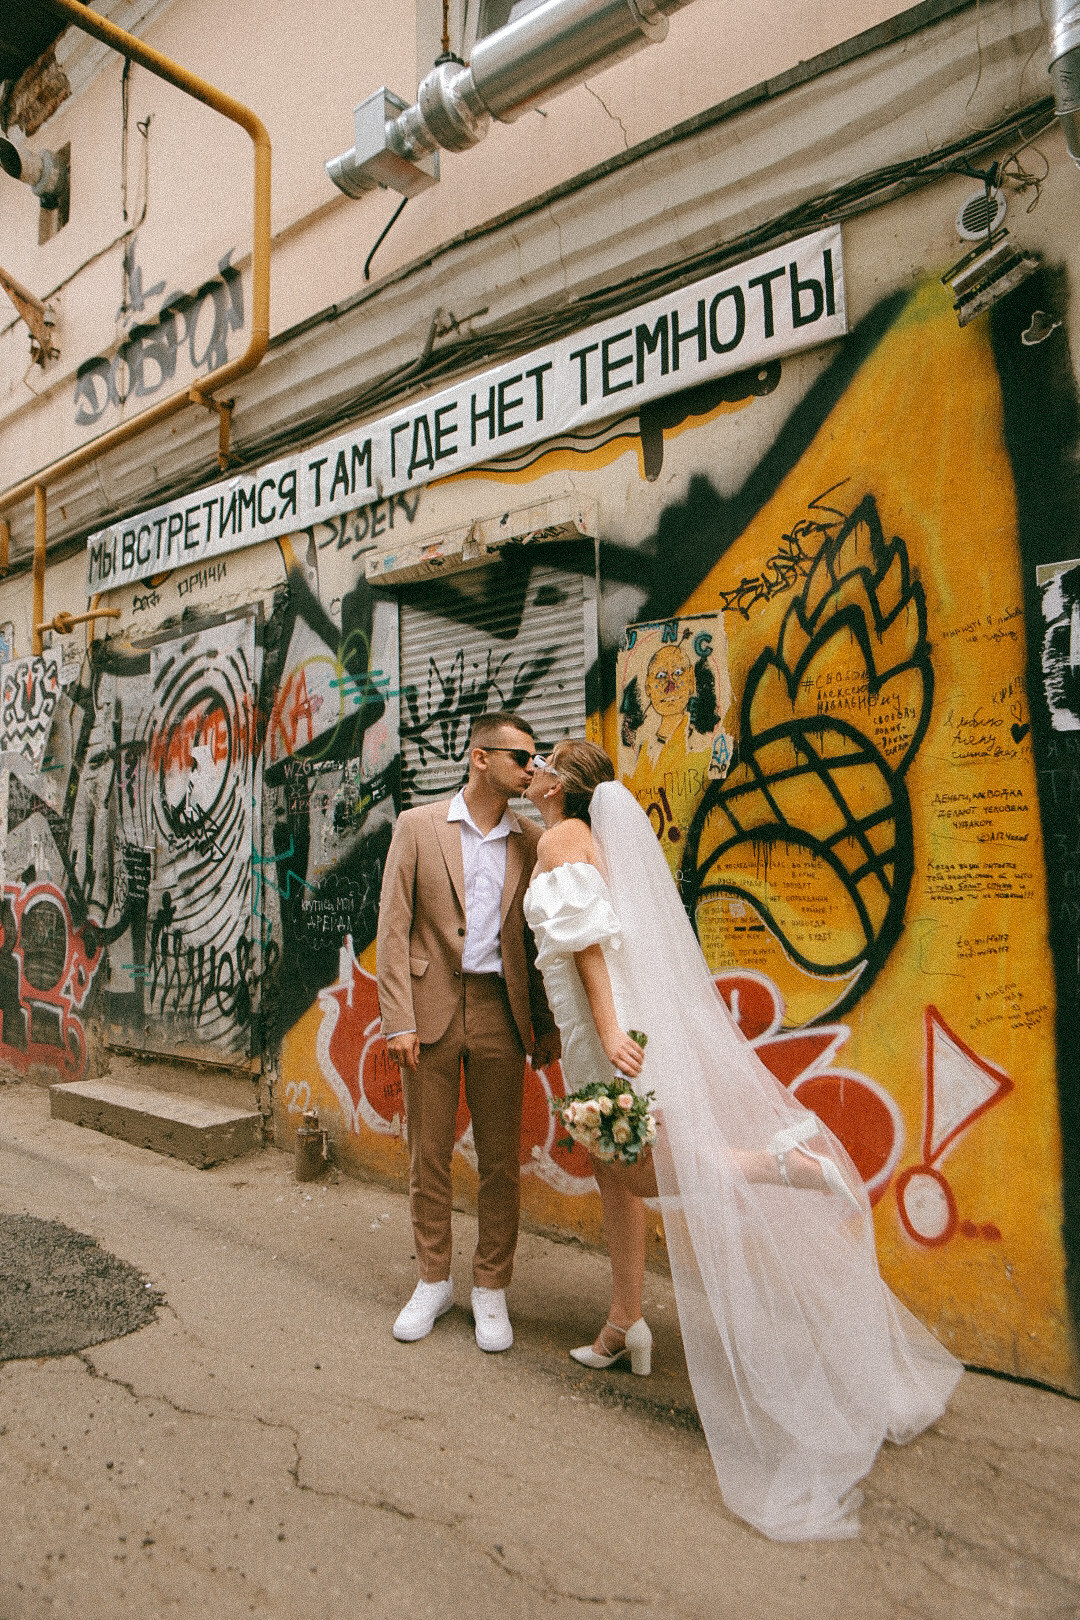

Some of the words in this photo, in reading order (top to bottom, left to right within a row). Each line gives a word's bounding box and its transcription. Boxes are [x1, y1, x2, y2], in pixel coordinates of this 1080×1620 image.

[88, 536, 117, 584] МЫ
[121, 469, 297, 570] ВСТРЕТИМСЯ
[308, 438, 372, 508] ТАМ
[389, 402, 458, 480] ГДЕ
[470, 361, 553, 447] НЕТ
[569, 248, 836, 407] ТЕМНОТЫ
